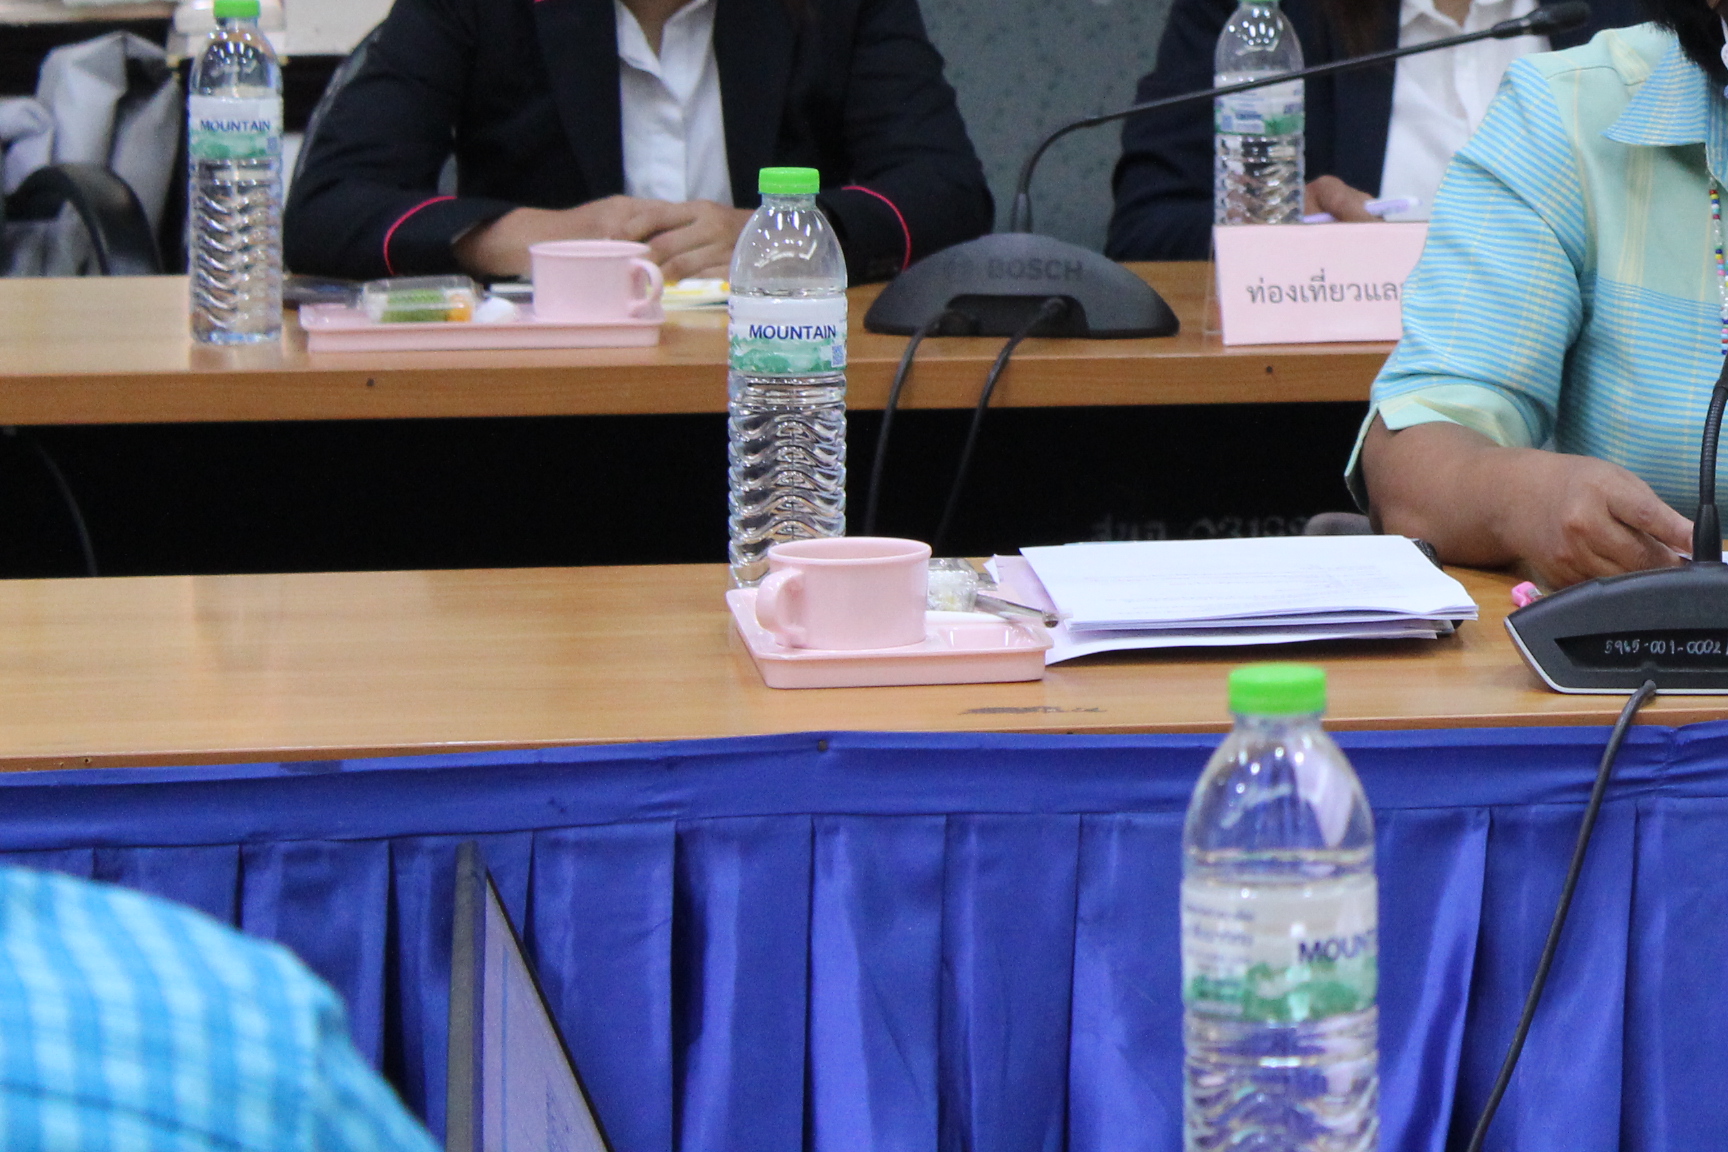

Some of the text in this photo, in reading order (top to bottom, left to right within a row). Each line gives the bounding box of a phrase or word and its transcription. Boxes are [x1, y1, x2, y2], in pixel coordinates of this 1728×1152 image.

[200, 120, 271, 133] MOUNTAIN
[987, 257, 1084, 282] BOSCH
[1246, 267, 1405, 304] ท่องเที่ยวแล
[749, 324, 837, 340] MOUNTAIN
